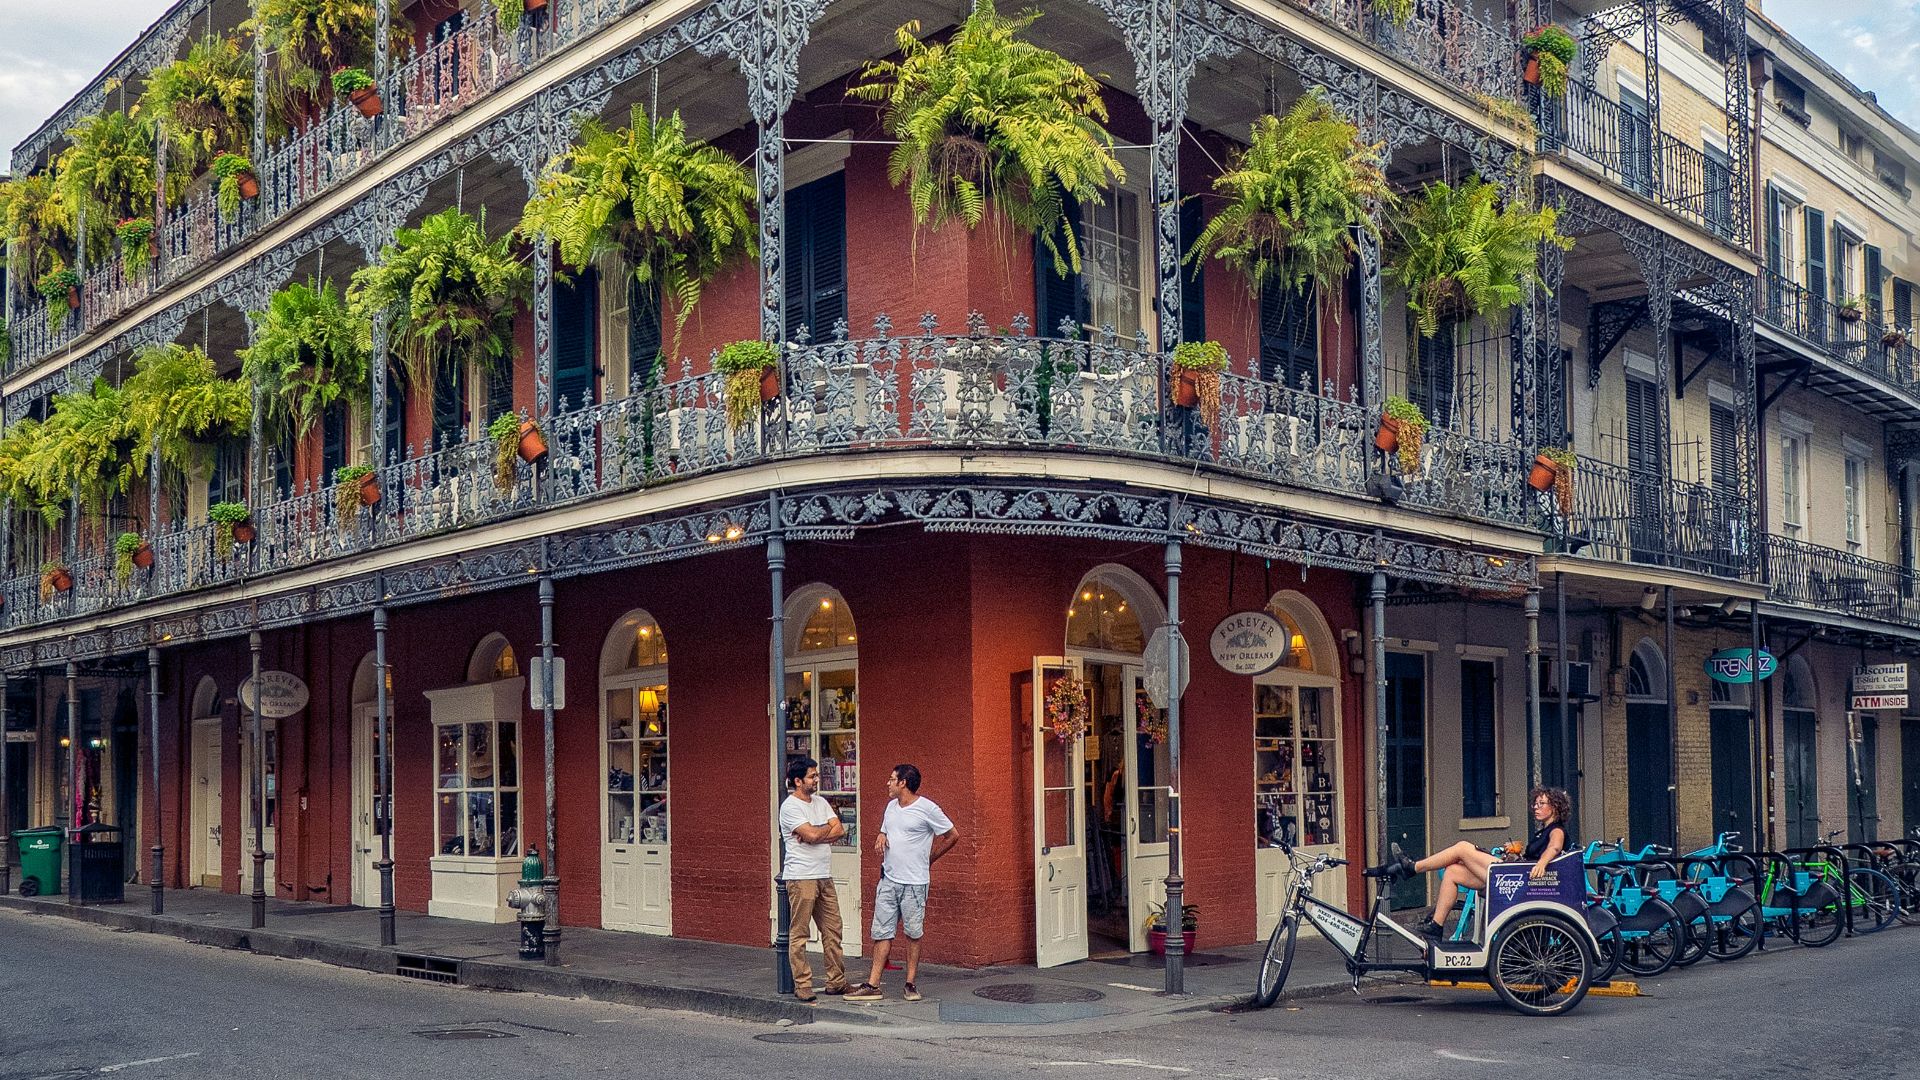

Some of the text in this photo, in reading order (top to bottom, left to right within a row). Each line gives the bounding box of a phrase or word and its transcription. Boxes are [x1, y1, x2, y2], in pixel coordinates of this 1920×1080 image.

[1220, 617, 1275, 638] FOREVER
[1854, 665, 1905, 675] Discount
[252, 675, 300, 689] OREVER
[1854, 697, 1906, 708] ATM INSIDE
[1495, 874, 1524, 890] Vintage
[1317, 909, 1331, 918] NEED
[1445, 956, 1472, 966] PC-22
